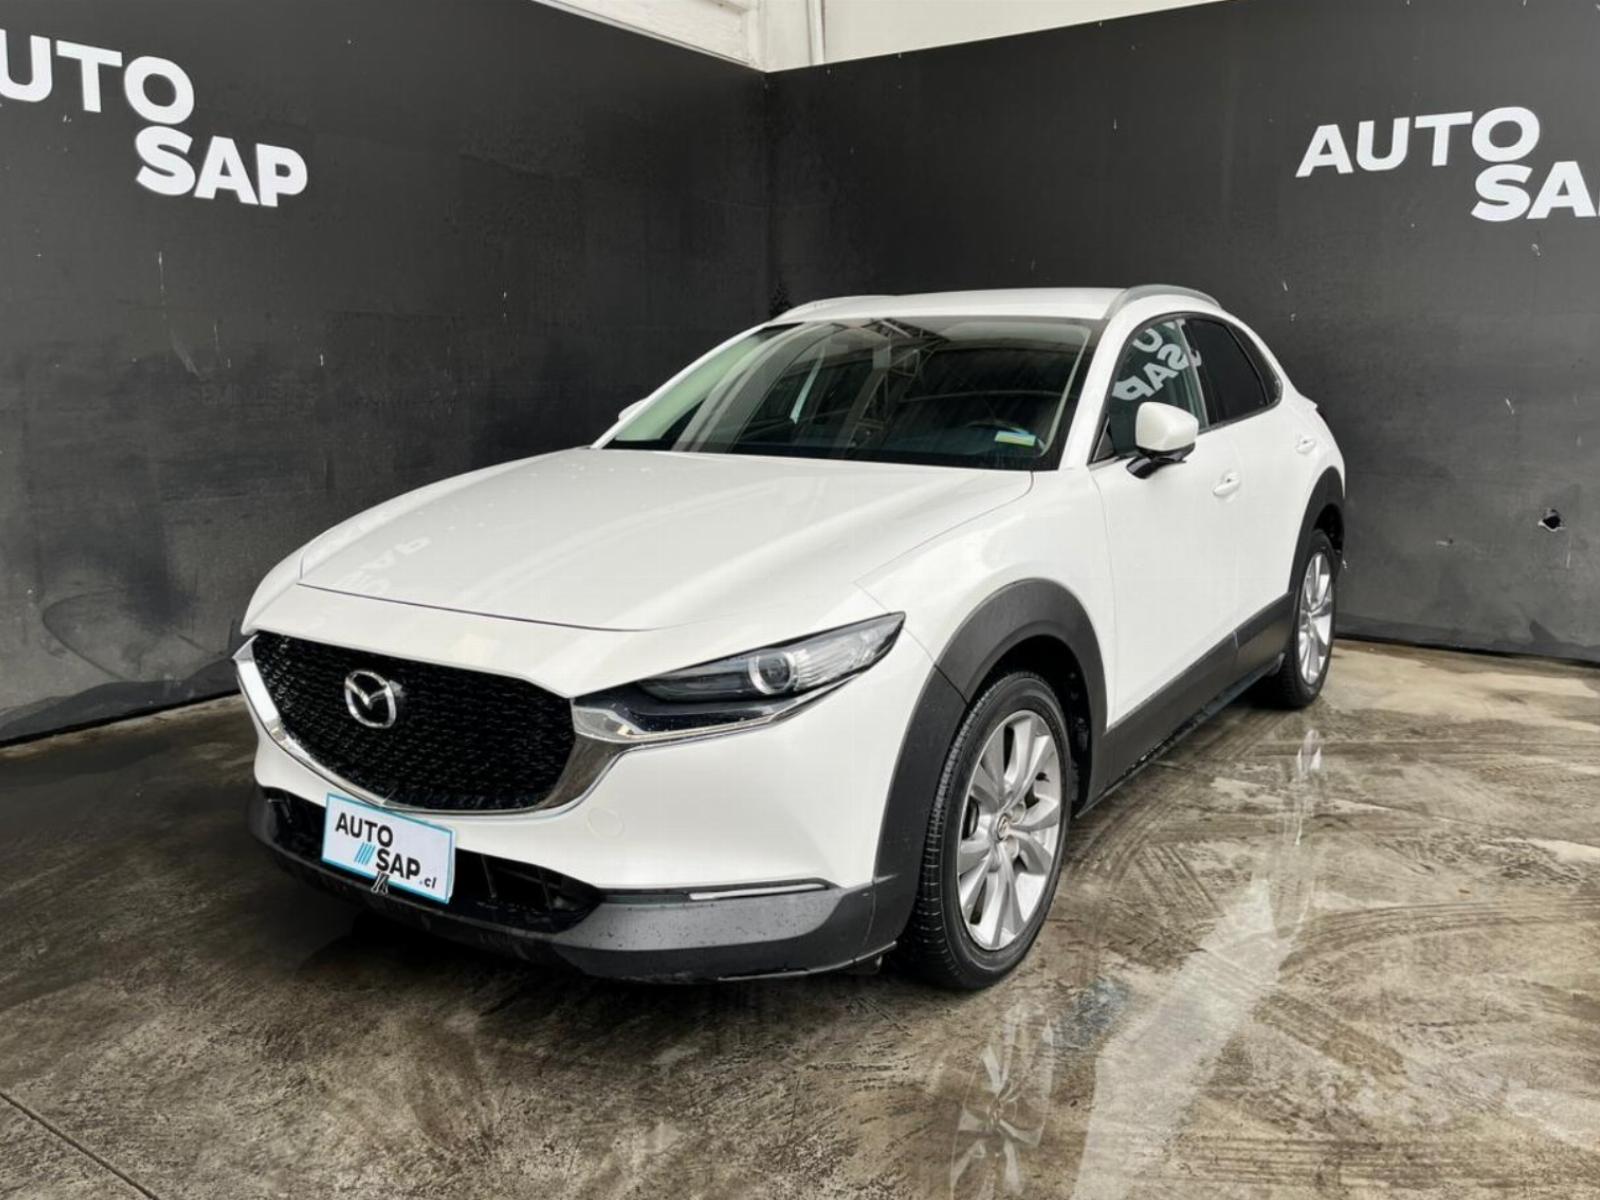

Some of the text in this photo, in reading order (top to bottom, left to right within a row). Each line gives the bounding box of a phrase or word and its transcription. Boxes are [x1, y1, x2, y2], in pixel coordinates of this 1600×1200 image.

[0, 28, 195, 125] UTO
[135, 125, 308, 207] SAP
[1295, 106, 1541, 178] AUTO
[1470, 161, 1600, 222] SA
[335, 812, 394, 848] AUTO
